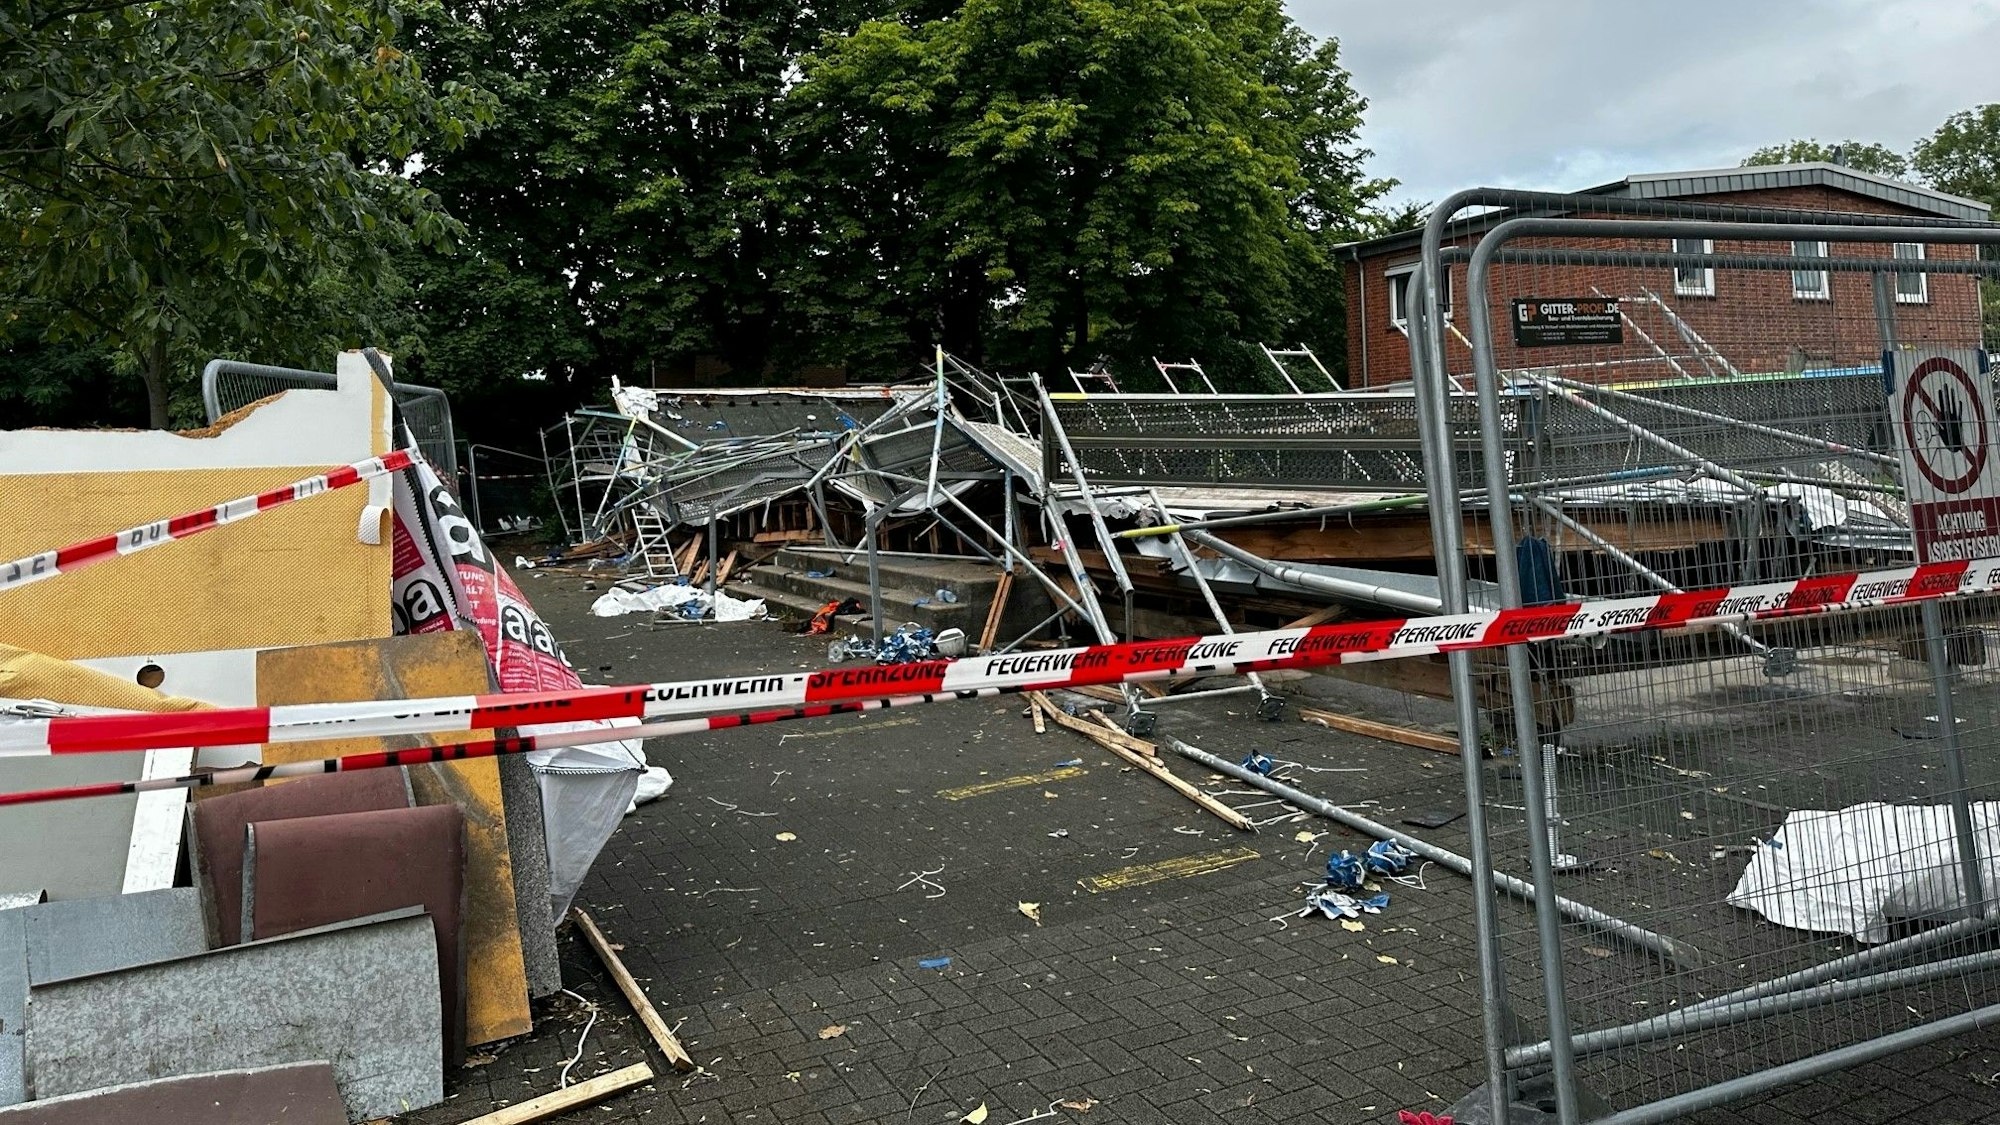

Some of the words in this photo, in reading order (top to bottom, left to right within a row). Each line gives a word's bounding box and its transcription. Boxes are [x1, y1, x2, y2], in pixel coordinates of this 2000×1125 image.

[1540, 302, 1620, 315] GITTER-PROFI.DE
[1937, 510, 1986, 536] ACHTUNG
[985, 650, 1111, 676] FEUERWEHR
[1129, 640, 1244, 665] SPERRZONE
[1267, 631, 1373, 655] FEUERWEHR
[1385, 622, 1482, 646] SPERRZONE
[1501, 612, 1590, 636] FEUERWEHR
[1597, 604, 1676, 627] SPERRZONE
[1690, 594, 1765, 617] FEUERWEHR
